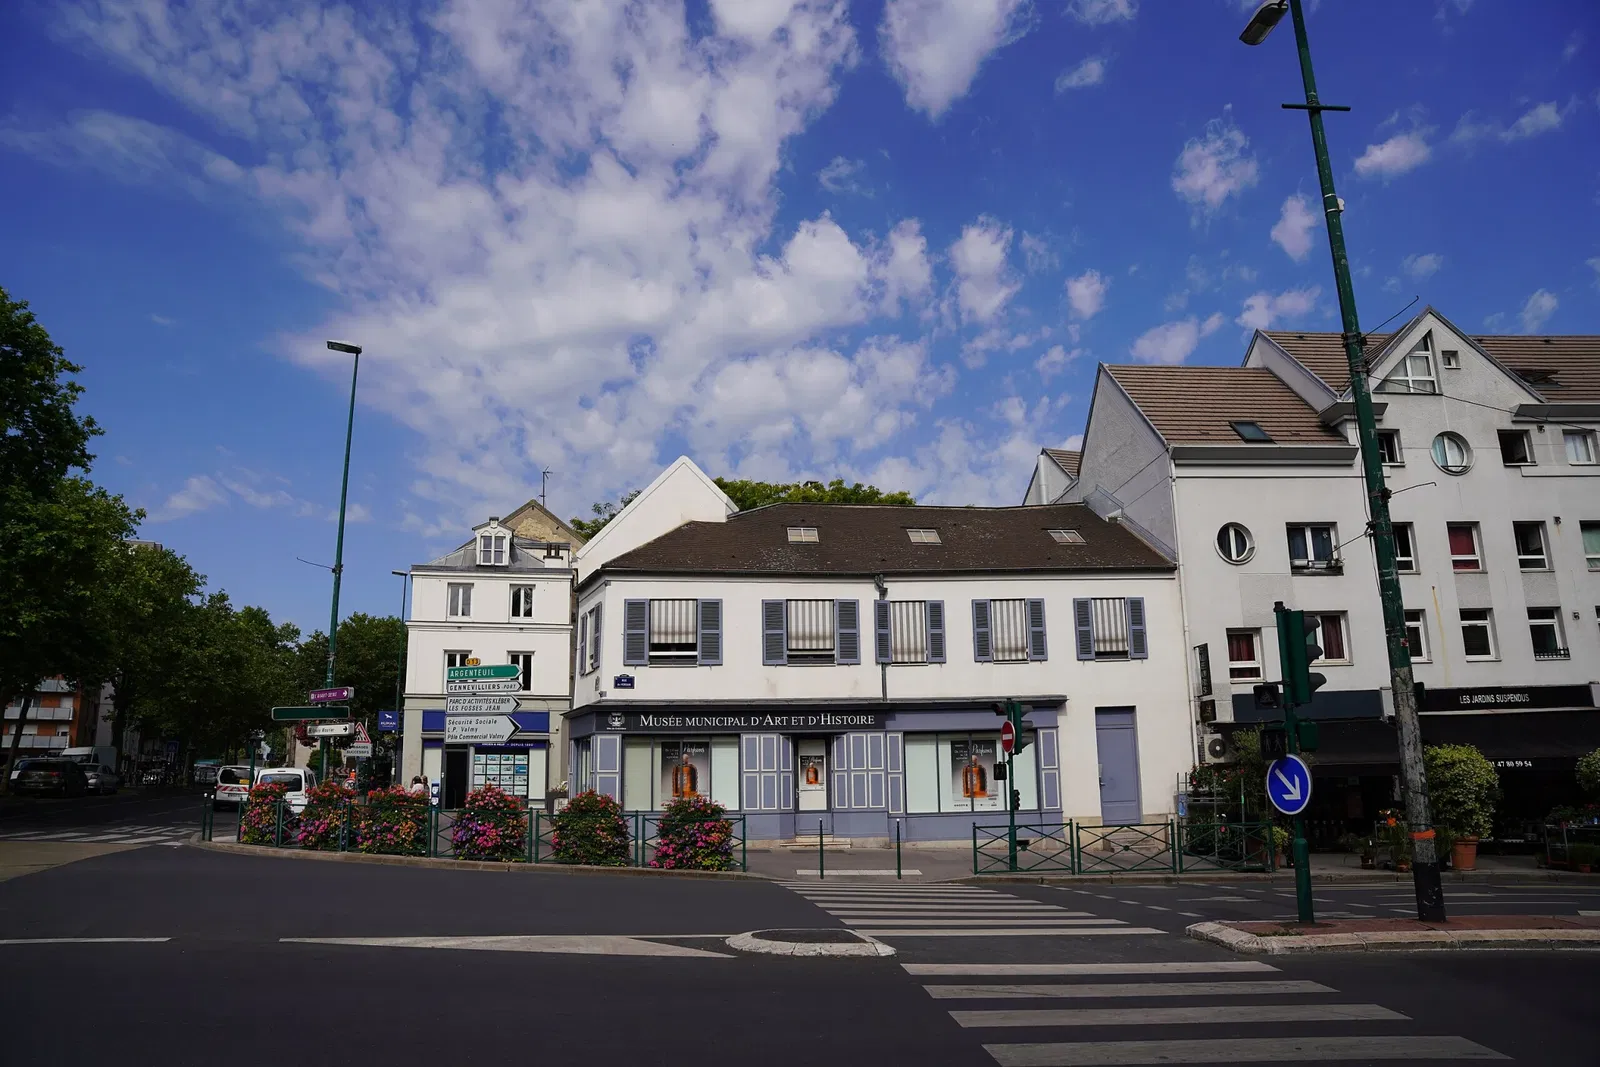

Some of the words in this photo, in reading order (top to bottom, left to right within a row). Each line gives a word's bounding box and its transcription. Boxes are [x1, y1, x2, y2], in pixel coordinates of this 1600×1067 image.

[450, 669, 495, 677] ARGENTEUIL
[1460, 695, 1470, 704] LES
[1472, 694, 1495, 703] JARDINS
[1496, 693, 1530, 703] SUSPENDUS
[640, 714, 683, 727] MUSÉE
[685, 716, 748, 727] MUNICIPAL
[791, 715, 805, 726] ET
